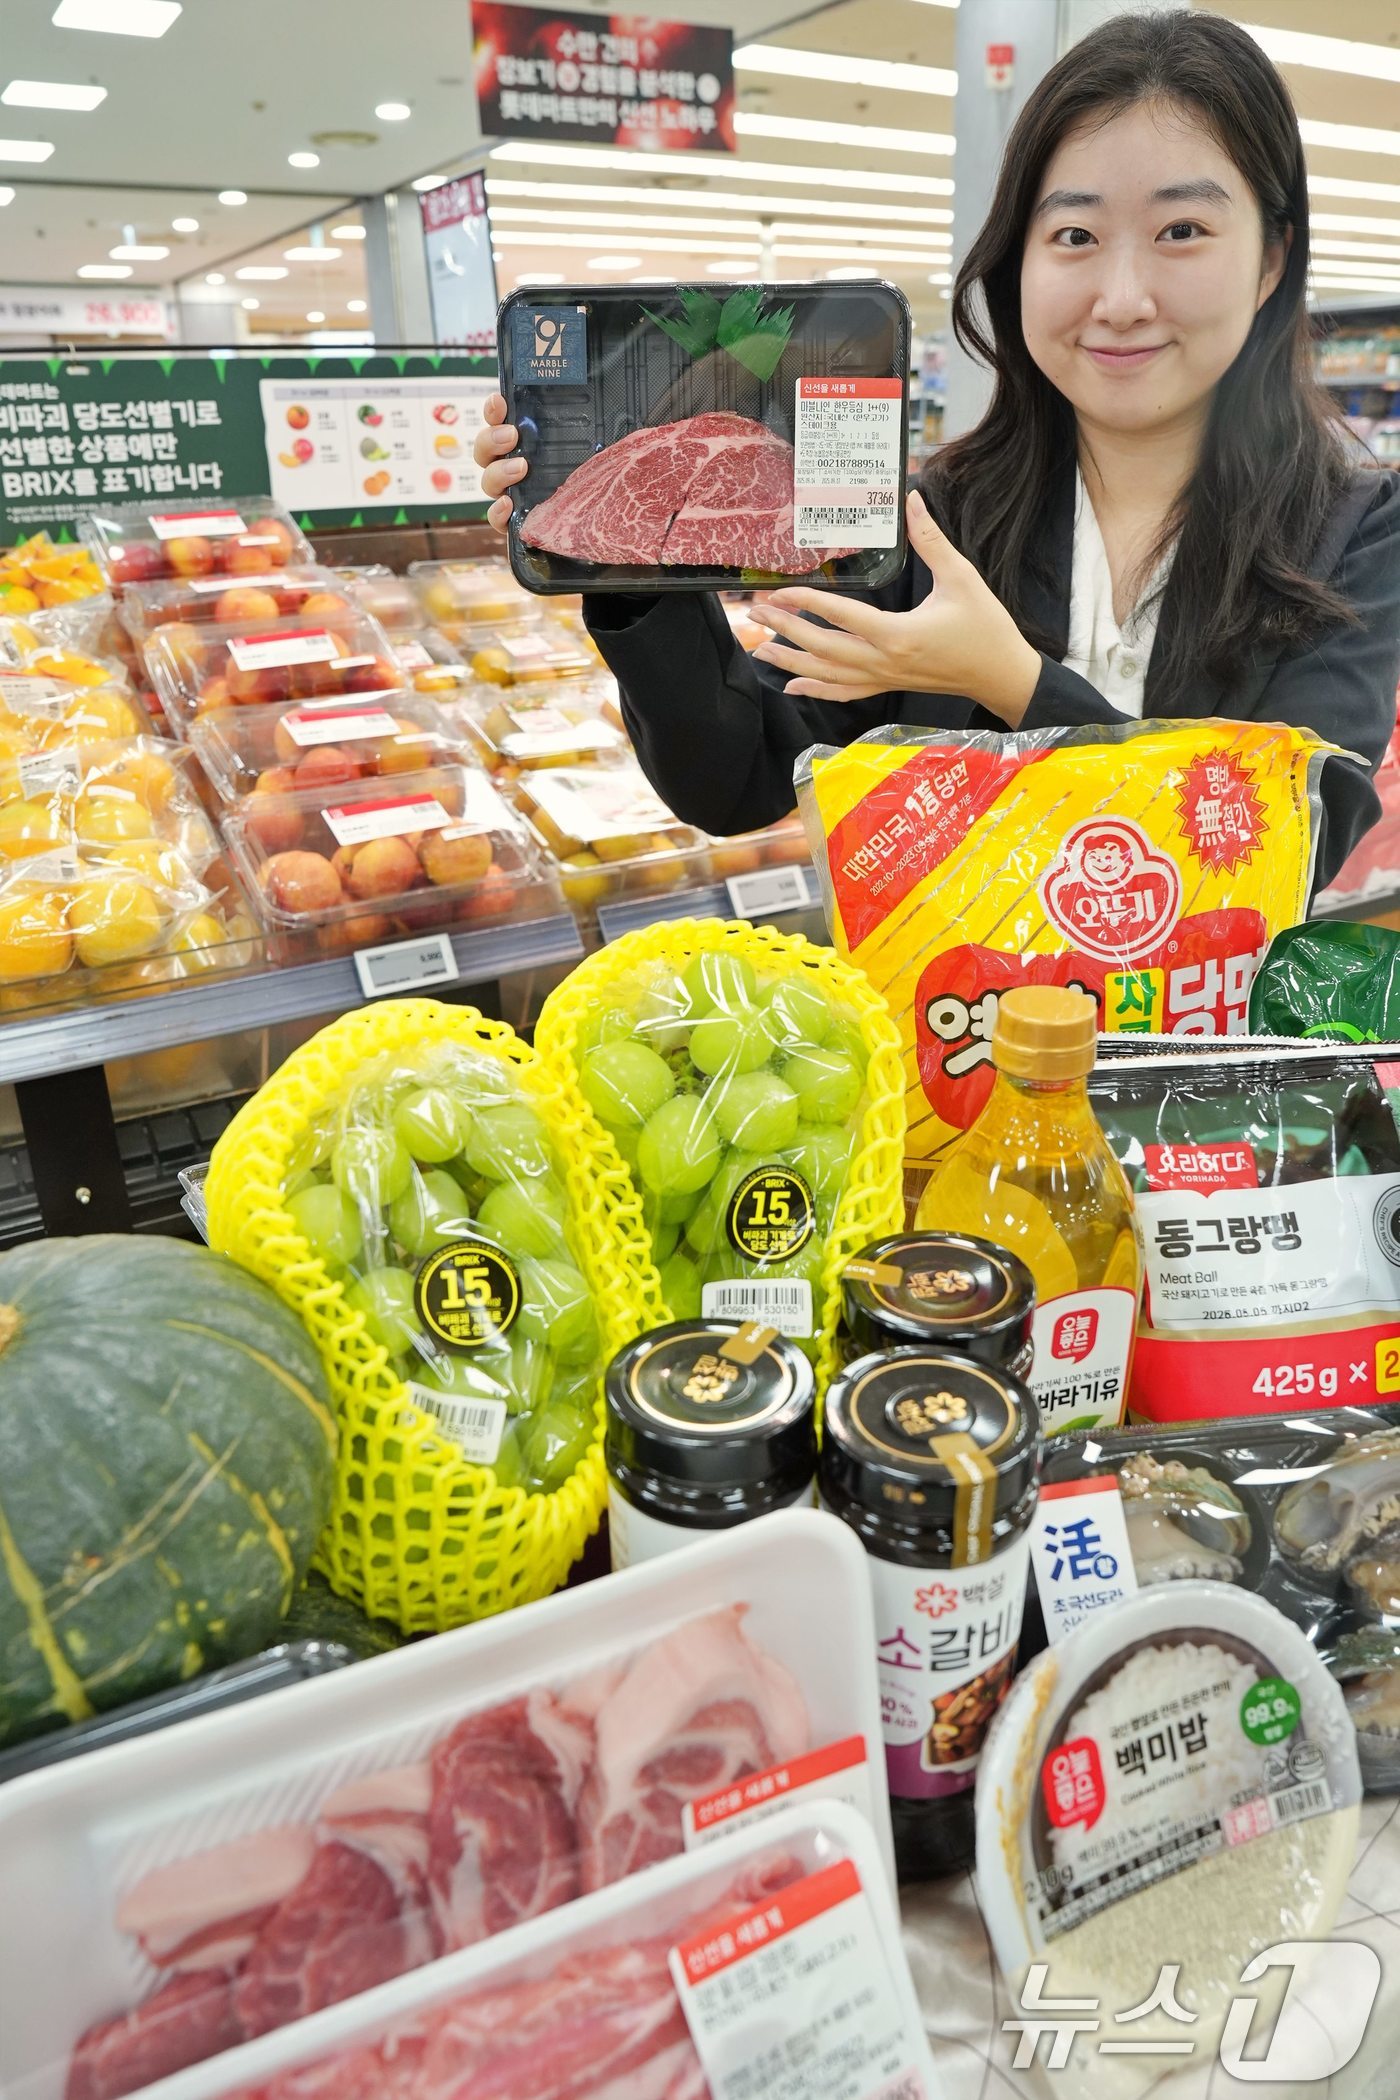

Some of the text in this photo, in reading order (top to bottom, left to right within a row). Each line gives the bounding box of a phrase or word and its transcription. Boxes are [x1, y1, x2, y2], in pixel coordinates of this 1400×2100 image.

[530, 359, 567, 368] MARBLE
[537, 369, 560, 378] NINE
[0, 382, 60, 401] 데마트는
[803, 383, 856, 394] 신선을 새롭게
[0, 399, 223, 433] 비파괴 당도선별기로
[800, 401, 890, 414] 마블나인 한우등심 1++(9)
[800, 413, 848, 422] 원산지:국내산
[800, 421, 837, 430] 스테이크용
[0, 432, 178, 467] 선별한 상품에만
[817, 459, 885, 469] 002187889514
[1, 462, 223, 498] BRIX를 표기합니다
[867, 491, 894, 505] 37366
[840, 813, 914, 882] 대한민국
[933, 760, 970, 800] 당면
[1194, 795, 1227, 849] 無
[1223, 801, 1252, 834] 첨가
[1075, 889, 1157, 928] 오뚜기
[1157, 1150, 1251, 1174] 요리하다
[765, 1179, 785, 1188] BRIX
[1180, 1175, 1227, 1183] YORIHADA
[748, 1190, 791, 1226] 15
[743, 1230, 768, 1241] 비파괴
[1154, 1211, 1302, 1259] 동그랑땡
[750, 1240, 769, 1252] 당도
[454, 1254, 480, 1267] BRIX
[1160, 1270, 1218, 1284] Meat Ball
[440, 1267, 492, 1309] 15
[1160, 1289, 1180, 1300] 국산
[1181, 1287, 1228, 1300] 돼지고기로
[1230, 1286, 1247, 1298] 만든
[764, 1305, 799, 1314] 530150
[449, 1324, 471, 1338] 당도
[1061, 1315, 1092, 1331] 오늘
[1060, 1329, 1089, 1351] 좋은
[1064, 1373, 1082, 1385] 100
[1103, 1365, 1121, 1377] 만든
[1252, 1363, 1338, 1398] 425g
[1384, 1350, 1400, 1380] 2
[1037, 1378, 1119, 1412] 바라기유
[1044, 1518, 1101, 1581] 活
[1115, 1712, 1208, 1775] 백미밥
[696, 1790, 743, 1824] 신선을
[687, 1931, 737, 1975] 신선을
